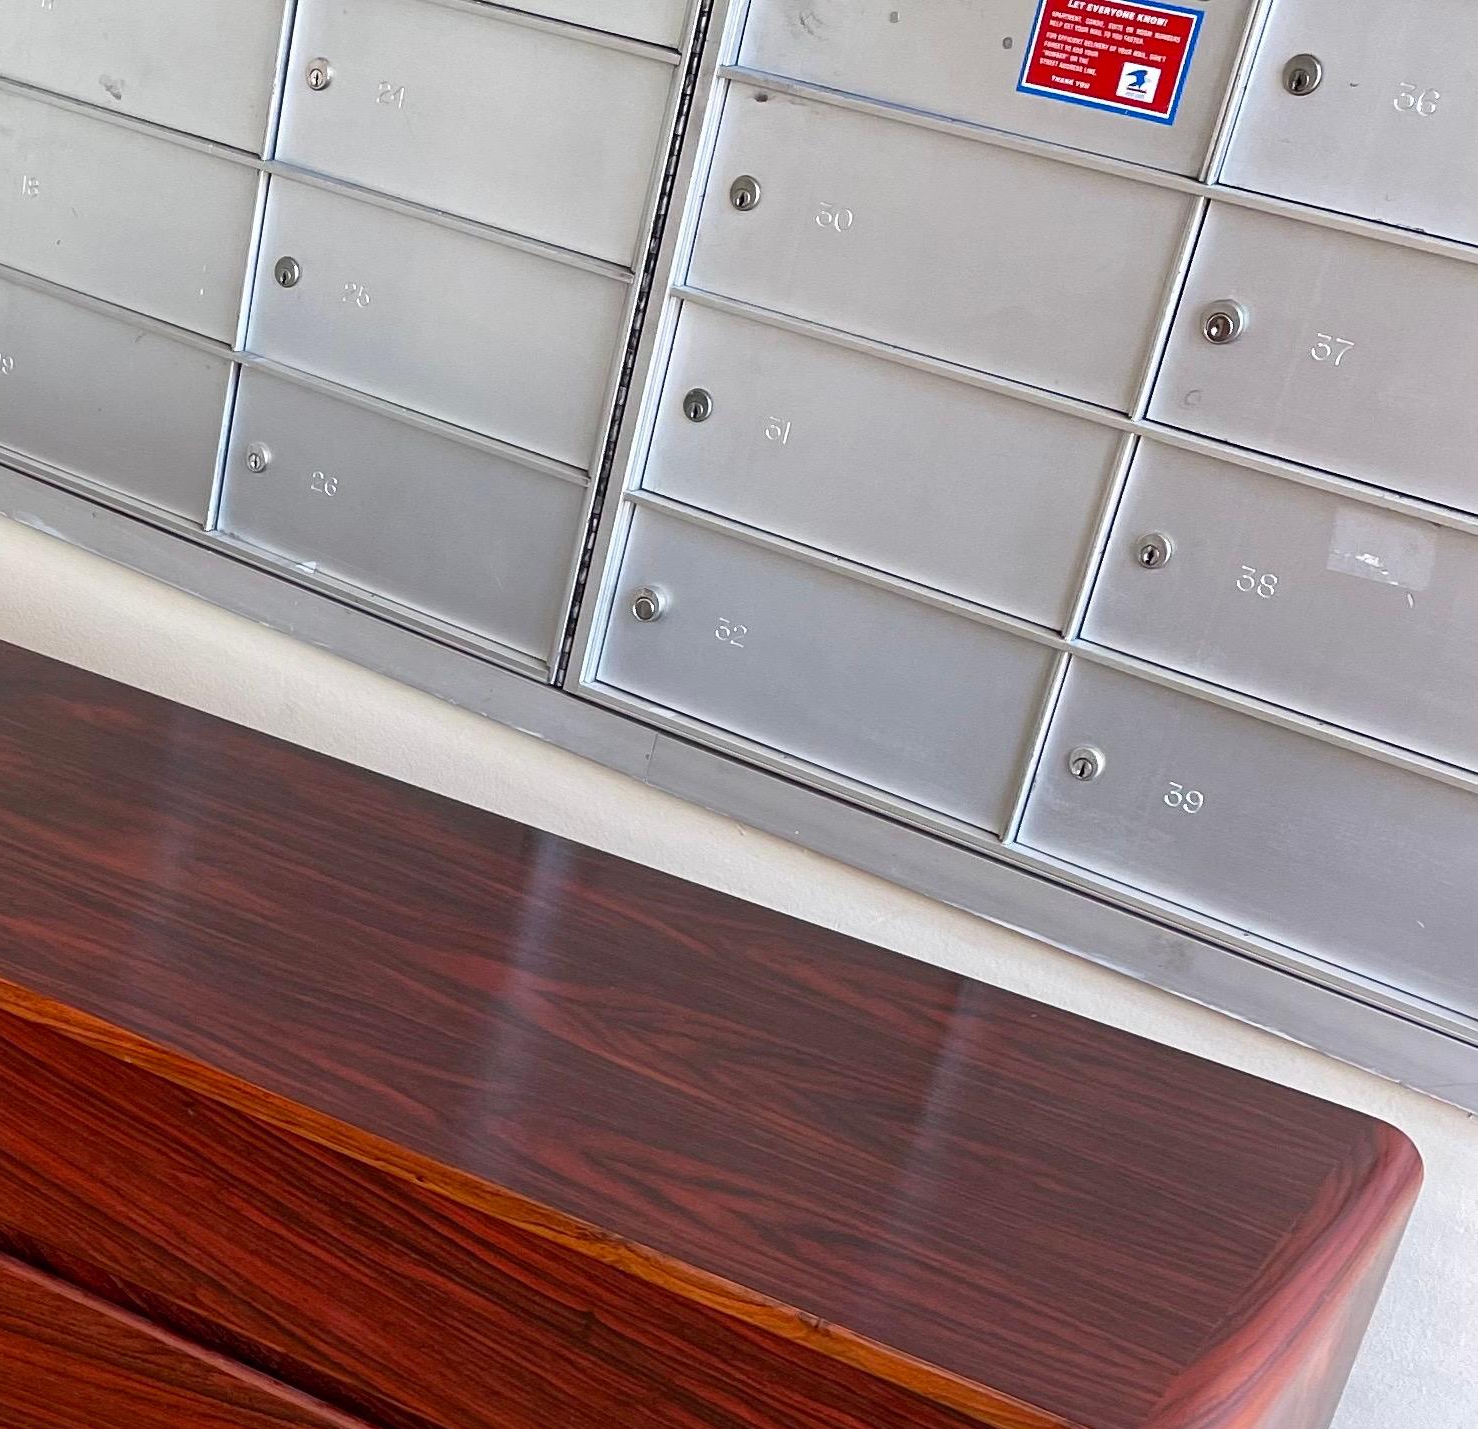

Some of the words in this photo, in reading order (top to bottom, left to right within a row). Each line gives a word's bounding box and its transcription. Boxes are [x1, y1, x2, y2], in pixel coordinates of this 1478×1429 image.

[1067, 0, 1086, 10] LET
[1086, 3, 1135, 20] EVERYONE
[1136, 13, 1169, 27] KNOW!
[1051, 74, 1075, 86] THANK
[1393, 82, 1440, 117] 36
[815, 201, 853, 232] 30
[342, 281, 370, 308] 25
[1311, 332, 1354, 366] 37
[765, 416, 791, 445] 31
[310, 470, 338, 497] 26
[1236, 565, 1278, 598] 38
[715, 617, 748, 648] 32
[1164, 781, 1204, 814] 39
